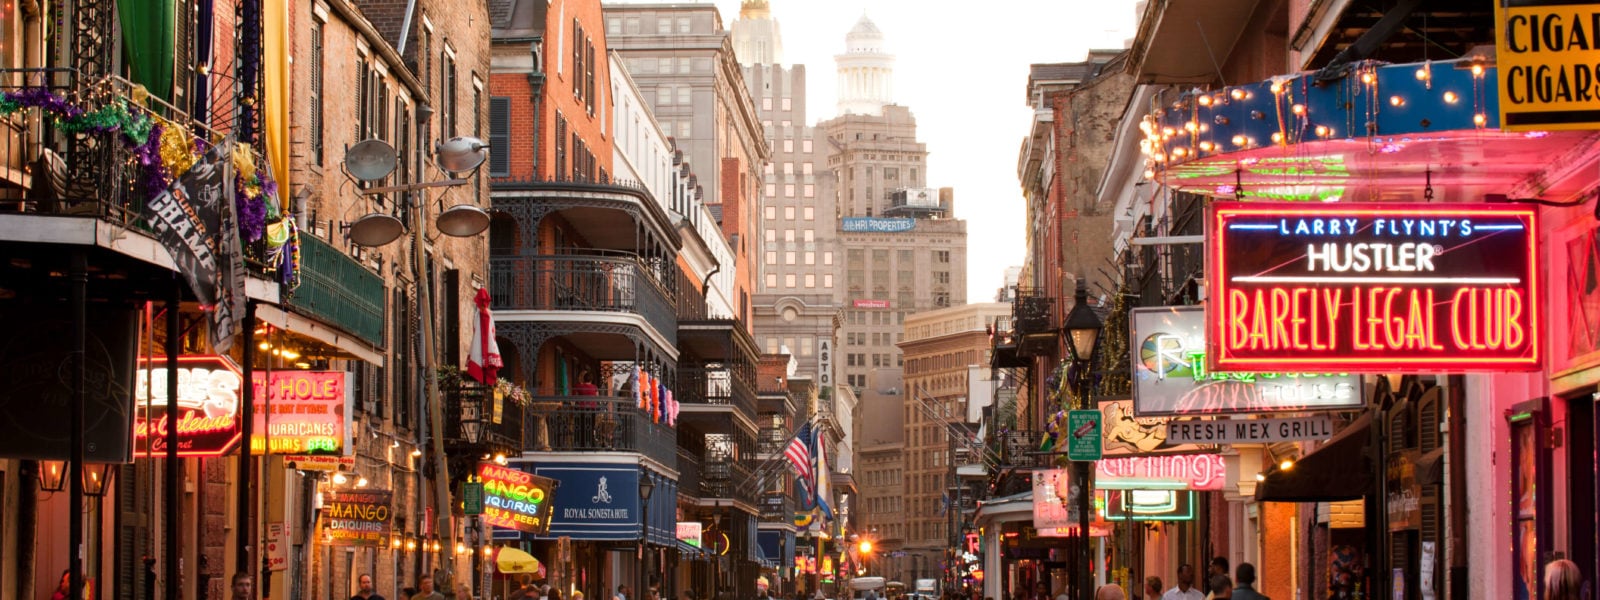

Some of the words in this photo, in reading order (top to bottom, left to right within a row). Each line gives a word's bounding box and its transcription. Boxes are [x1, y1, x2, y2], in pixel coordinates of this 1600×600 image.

[172, 187, 207, 238] SUPER
[855, 220, 868, 231] HRI
[869, 220, 911, 231] PROPERTIES
[1280, 219, 1358, 236] LARRY
[1375, 219, 1472, 237] FLYNT'S
[1228, 286, 1342, 351] BARELY
[1352, 286, 1444, 351] LEGAL
[1451, 286, 1524, 351] CLUB
[820, 340, 830, 385] ASTO
[280, 377, 338, 400] HOLE
[1262, 382, 1352, 401] HOUSE
[1170, 423, 1226, 441] FRESH
[1235, 420, 1270, 439] MEX
[1279, 417, 1330, 438] GRILL
[151, 436, 194, 451] Caret
[482, 465, 531, 485] MANGO
[340, 493, 377, 503] MANGO
[329, 502, 388, 521] MANGO
[514, 513, 540, 527] BEER
[564, 508, 587, 519] ROYAL
[588, 508, 613, 519] SONESTA
[614, 508, 629, 519] HOTEL
[331, 519, 383, 531] DAIQUIRIS
[483, 514, 517, 529] IZZA
